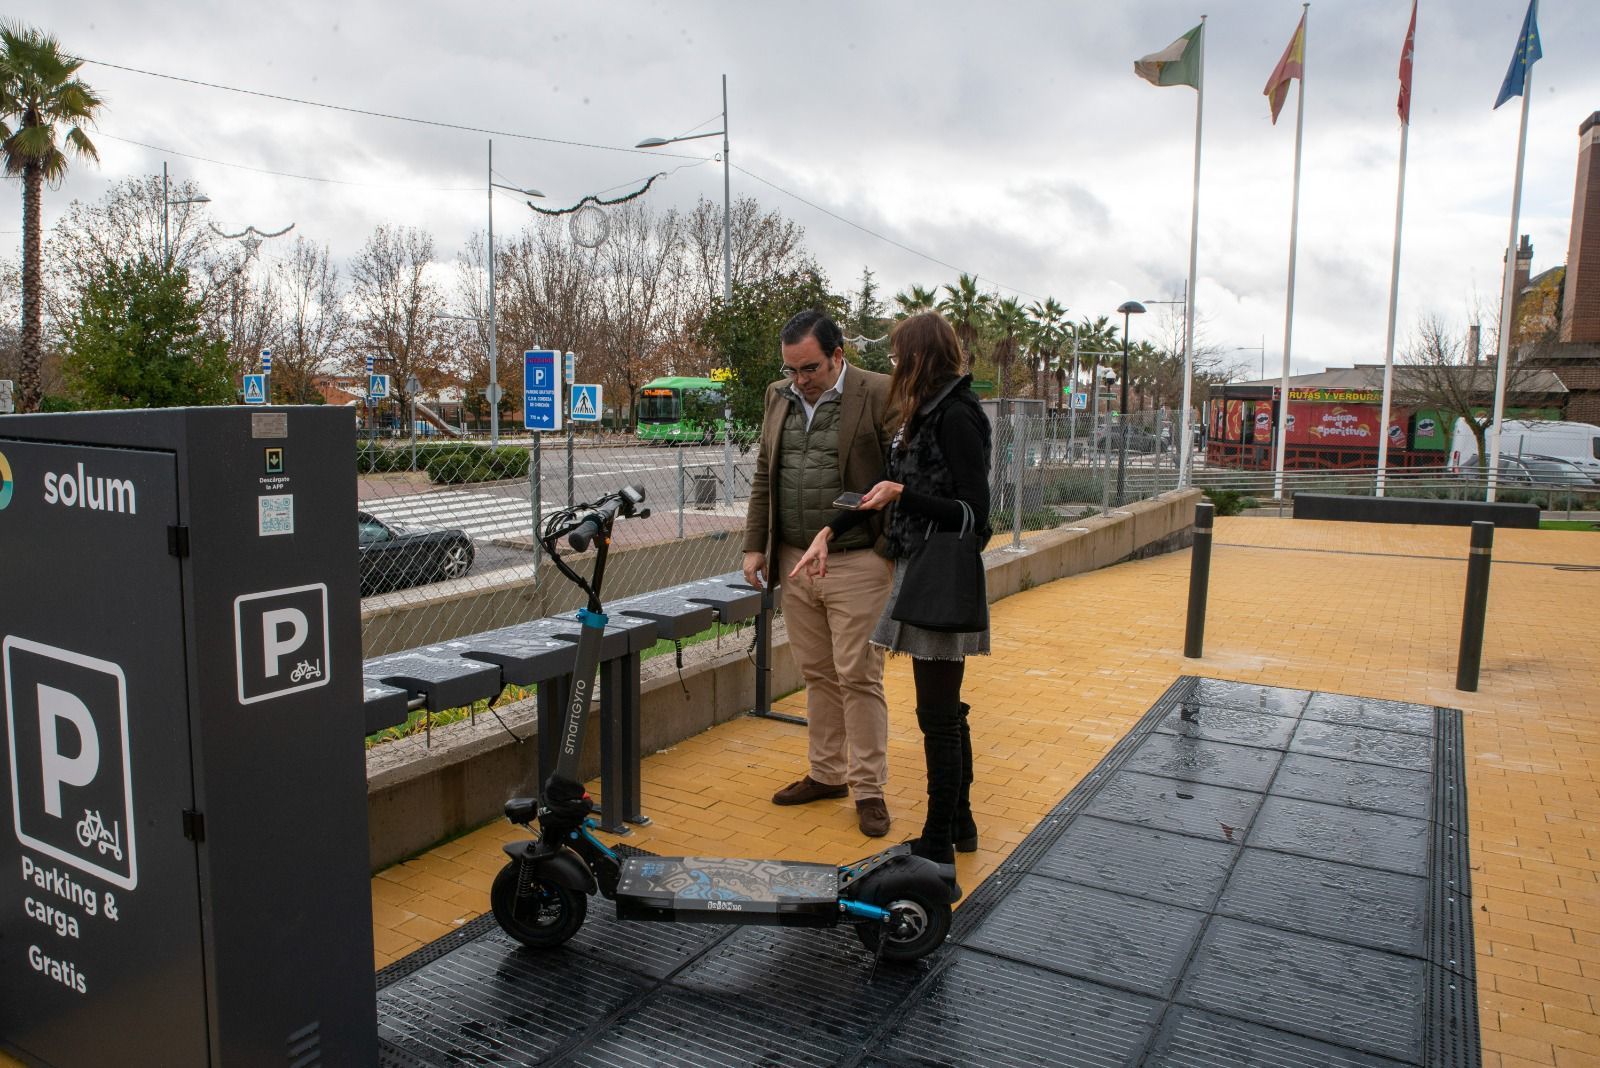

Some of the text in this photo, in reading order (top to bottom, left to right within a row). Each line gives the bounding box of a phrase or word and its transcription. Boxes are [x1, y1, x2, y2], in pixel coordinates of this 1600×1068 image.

[535, 369, 544, 385] P
[1324, 391, 1332, 400] Y
[1333, 391, 1384, 401] VERDURA
[1317, 424, 1367, 437] aperitivo
[44, 462, 136, 515] solum
[262, 607, 309, 678] P
[37, 683, 100, 819] P
[21, 855, 119, 922] Parking &
[25, 897, 79, 939] carga
[28, 945, 87, 994] Gratis
